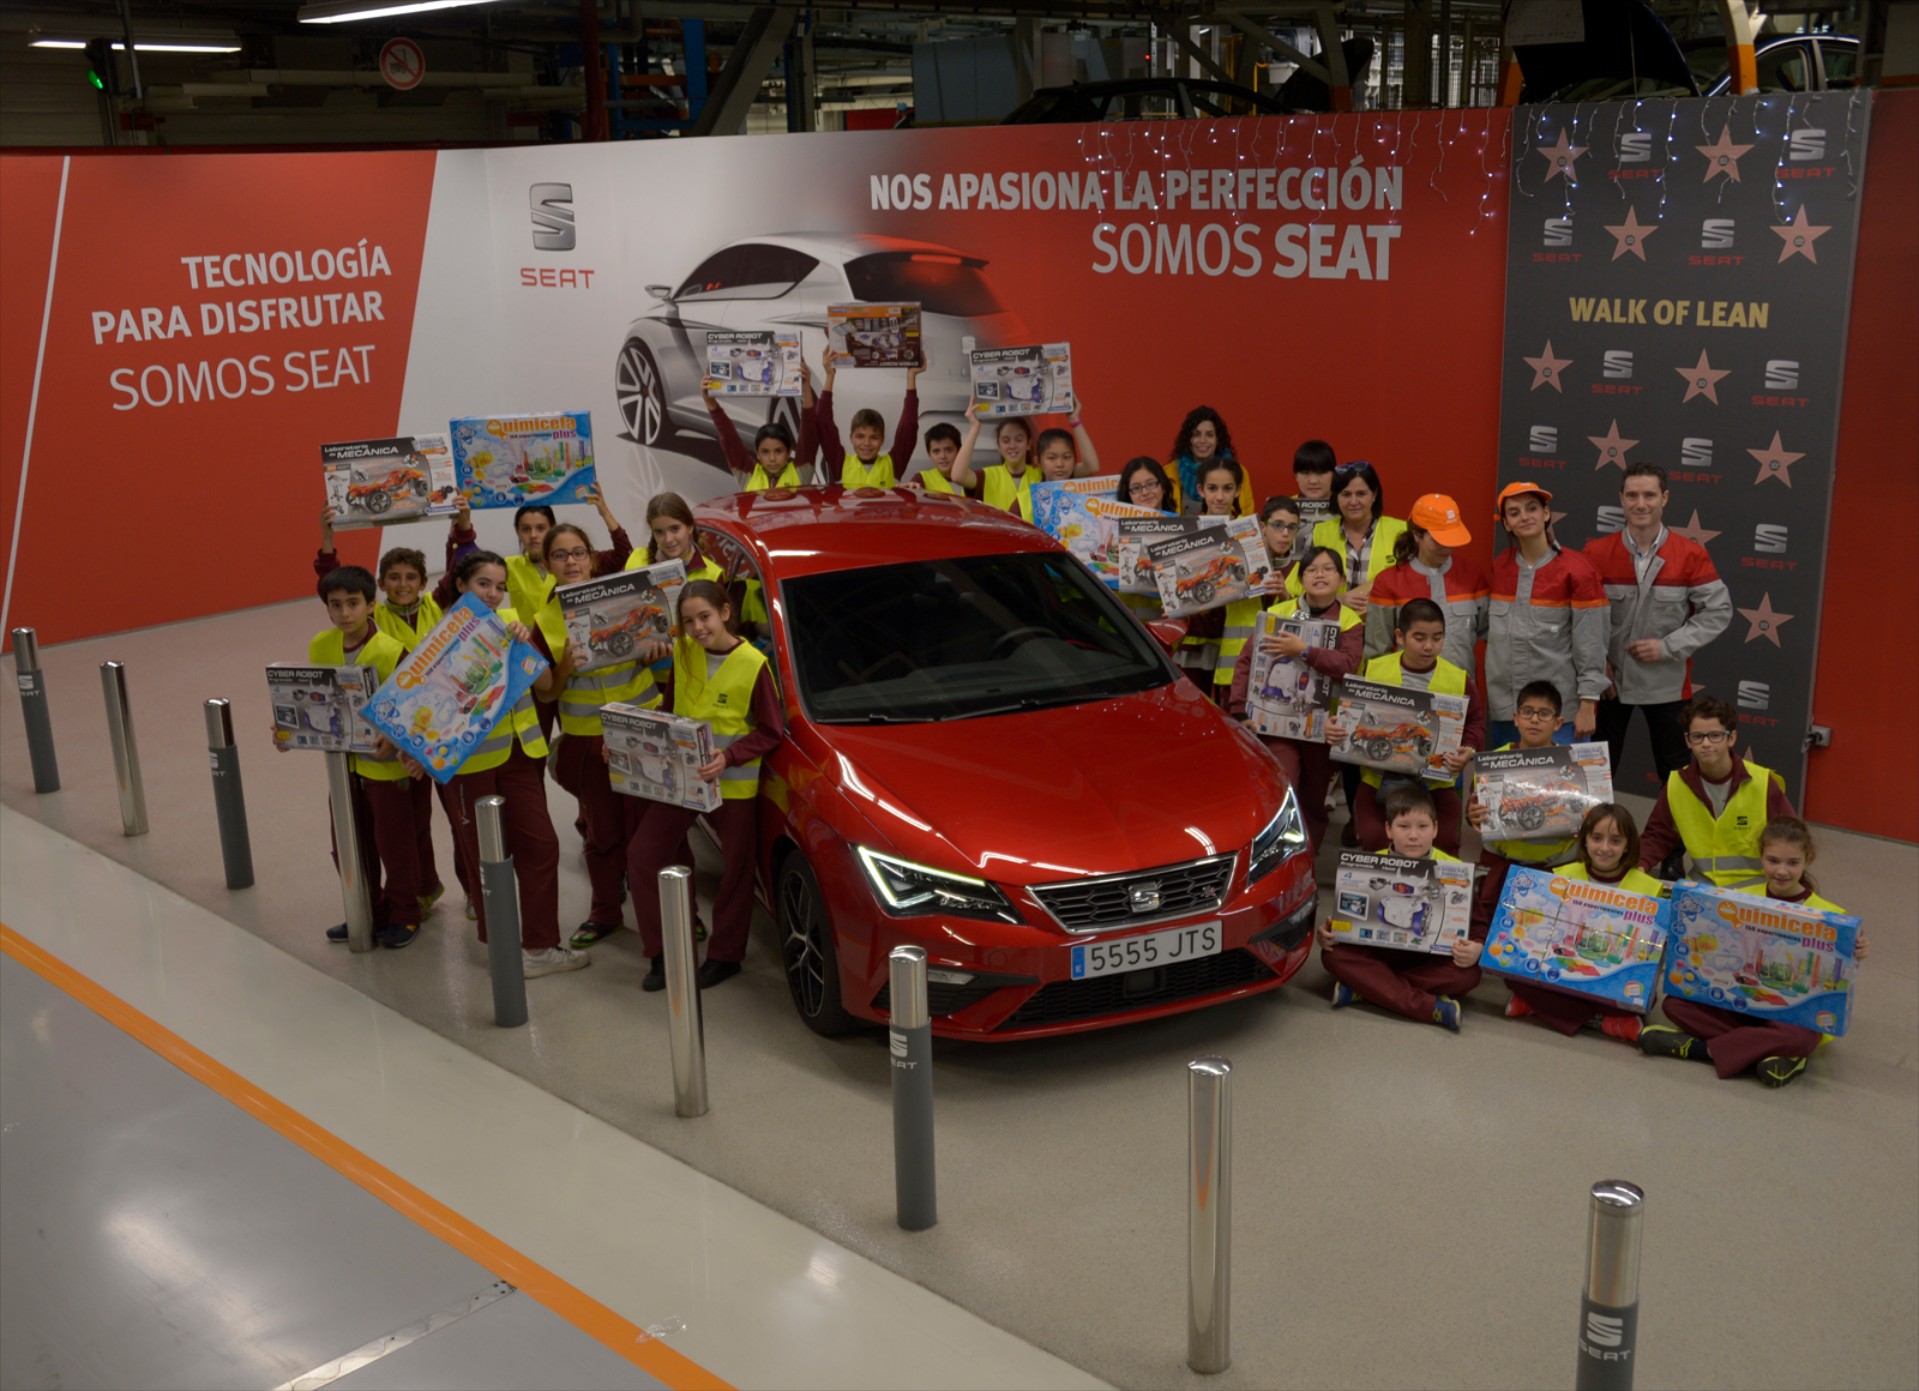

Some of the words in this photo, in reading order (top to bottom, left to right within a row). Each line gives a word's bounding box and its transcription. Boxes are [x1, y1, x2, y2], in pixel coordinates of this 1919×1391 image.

[1607, 168, 1661, 180] SEAT
[1775, 166, 1837, 179] SEAT
[870, 173, 932, 210] NOS
[938, 171, 1105, 210] APASIONA
[1114, 170, 1160, 210] LA
[1166, 155, 1403, 210] PERFECCIÓN
[1091, 222, 1263, 278] SOMOS
[1273, 223, 1402, 280] SEAT
[1531, 252, 1582, 264] SEAT
[181, 238, 391, 289] TECNOLOGÍA
[1688, 255, 1745, 266] SEAT
[519, 267, 595, 289] SEAT
[91, 304, 192, 345] PARA
[201, 290, 385, 336] DISFRUTAR
[1569, 296, 1647, 324] WALK
[1653, 299, 1690, 325] OF
[1696, 301, 1769, 328] LEAN
[973, 351, 1001, 360] CYBER
[1001, 348, 1031, 356] ROBOT
[109, 354, 277, 411] SOMOS
[283, 344, 376, 392] SEAT
[1591, 383, 1644, 396] SEAT
[1750, 395, 1809, 408] SEAT
[486, 416, 577, 439] Quimicefa
[552, 430, 577, 441] plus
[1518, 456, 1567, 469] SEAT
[1669, 470, 1723, 484] SEAT
[1740, 557, 1798, 572] SEAT
[457, 616, 481, 642] plus
[396, 606, 475, 690] Quimicefa
[268, 670, 295, 678] CYBER
[296, 670, 324, 679] ROBOT
[601, 712, 628, 725] CYBER
[629, 718, 657, 730] ROBOT
[1738, 713, 1781, 729] EAT
[1340, 852, 1379, 864] CYBER
[1379, 857, 1420, 869] ROBOT
[1549, 877, 1659, 916] Quimicefa
[1623, 910, 1655, 926] plus
[1717, 900, 1838, 943] Quimicefa
[1091, 938, 1158, 971] 5555
[1169, 927, 1216, 958] JTS
[1801, 937, 1835, 953] plus
